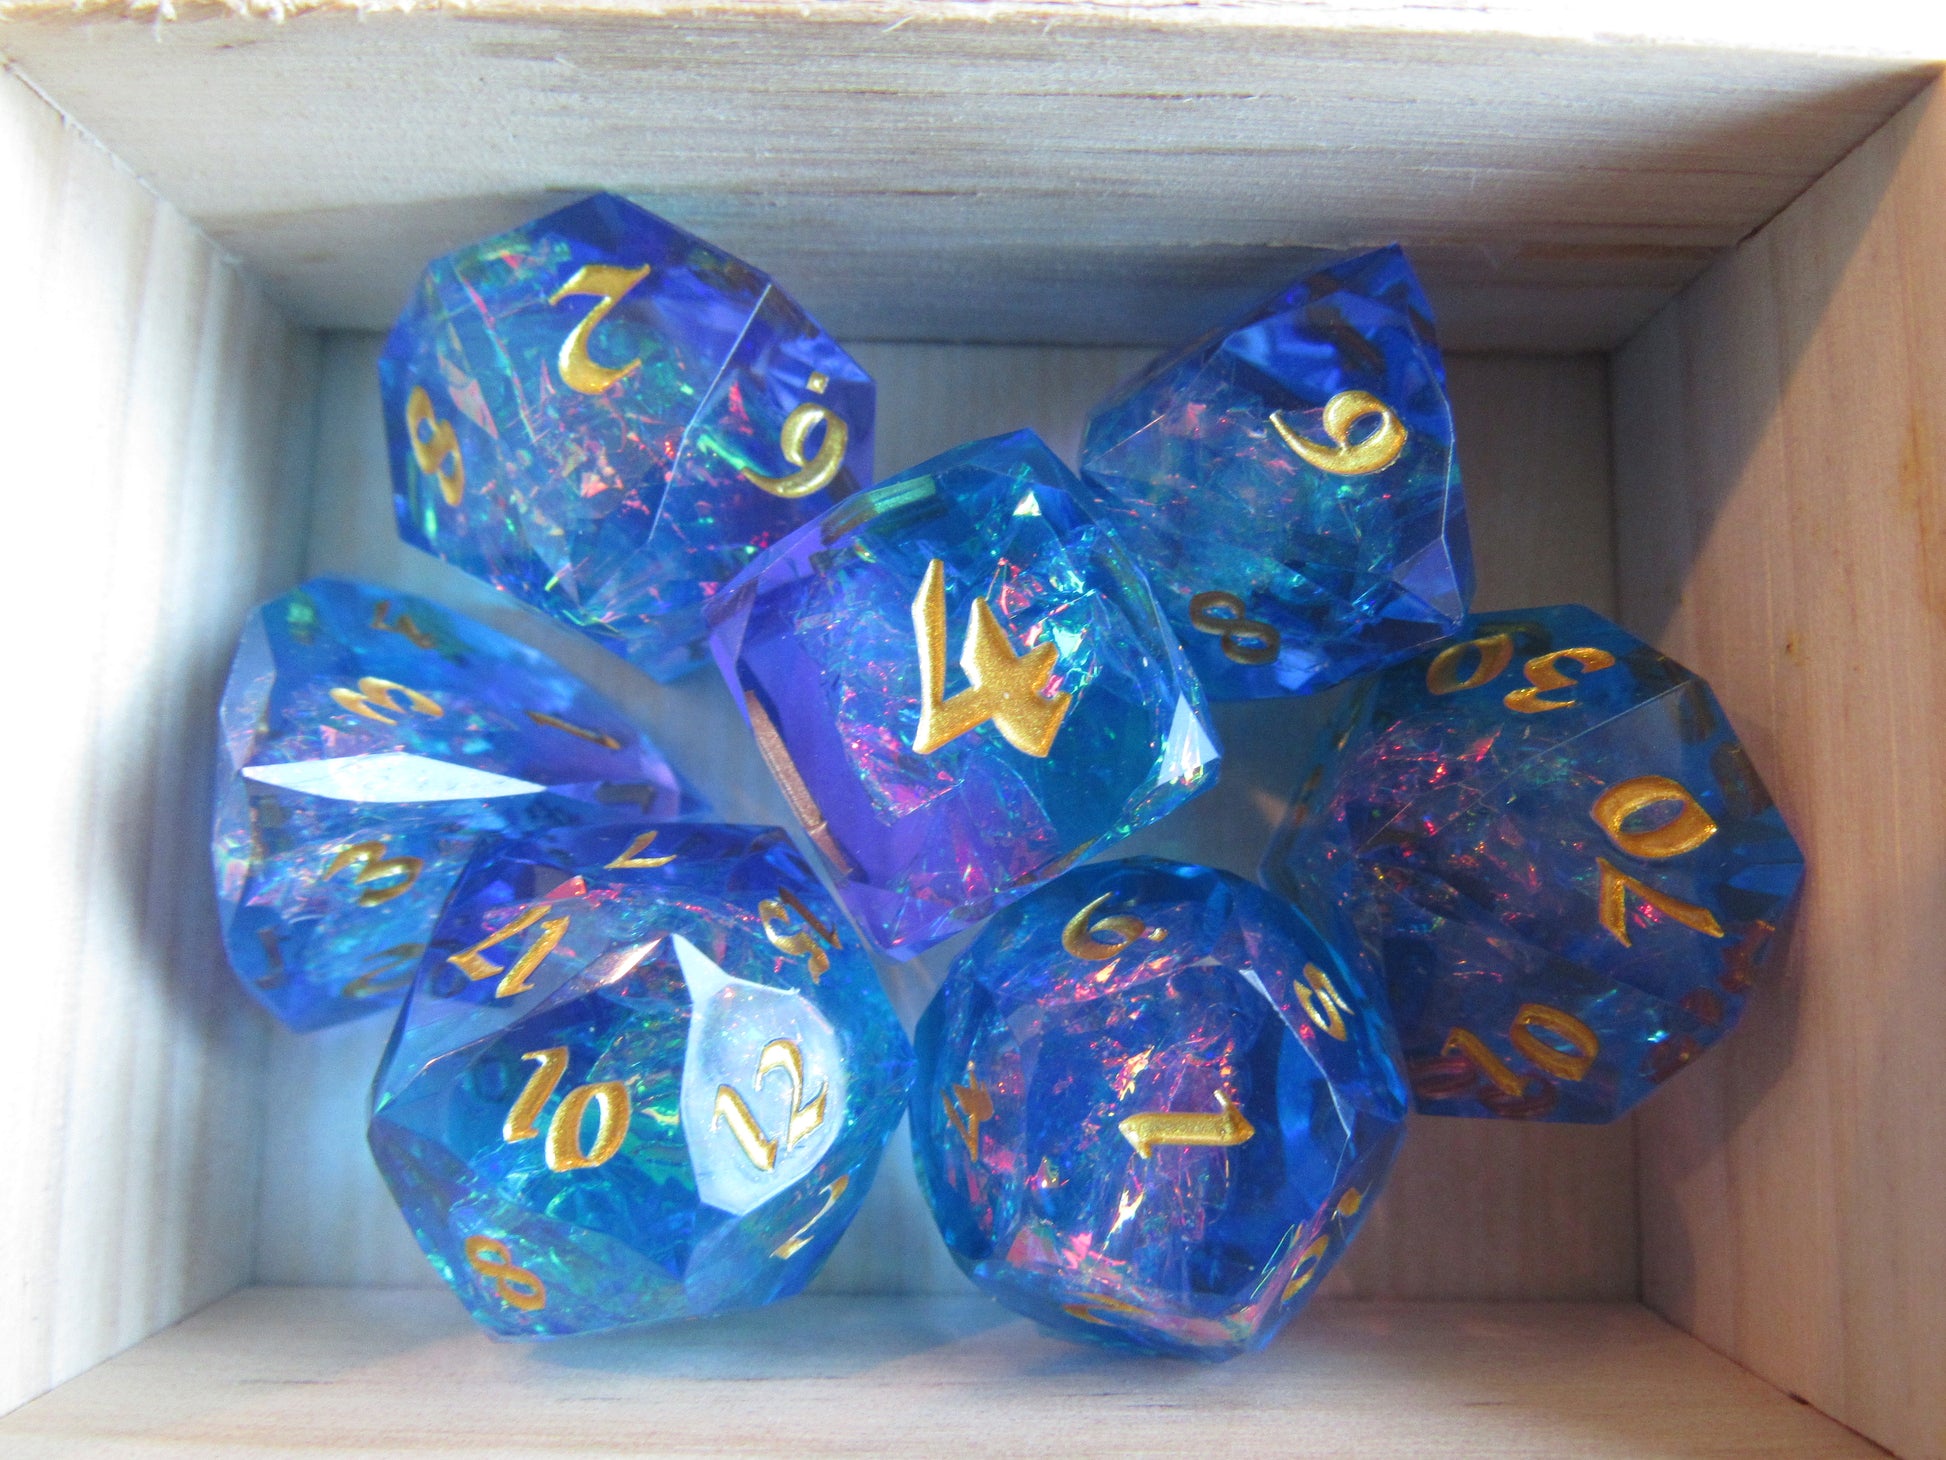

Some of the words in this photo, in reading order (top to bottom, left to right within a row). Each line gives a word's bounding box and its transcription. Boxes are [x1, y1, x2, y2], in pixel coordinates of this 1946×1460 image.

[406, 385, 465, 506] 8
[912, 558, 1063, 758] 4
[1189, 590, 1281, 665] 8
[322, 840, 425, 908] 3
[502, 1045, 631, 1173] 10
[711, 1037, 829, 1173] 12
[1118, 1089, 1256, 1160] 1
[464, 1234, 547, 1311] 8
